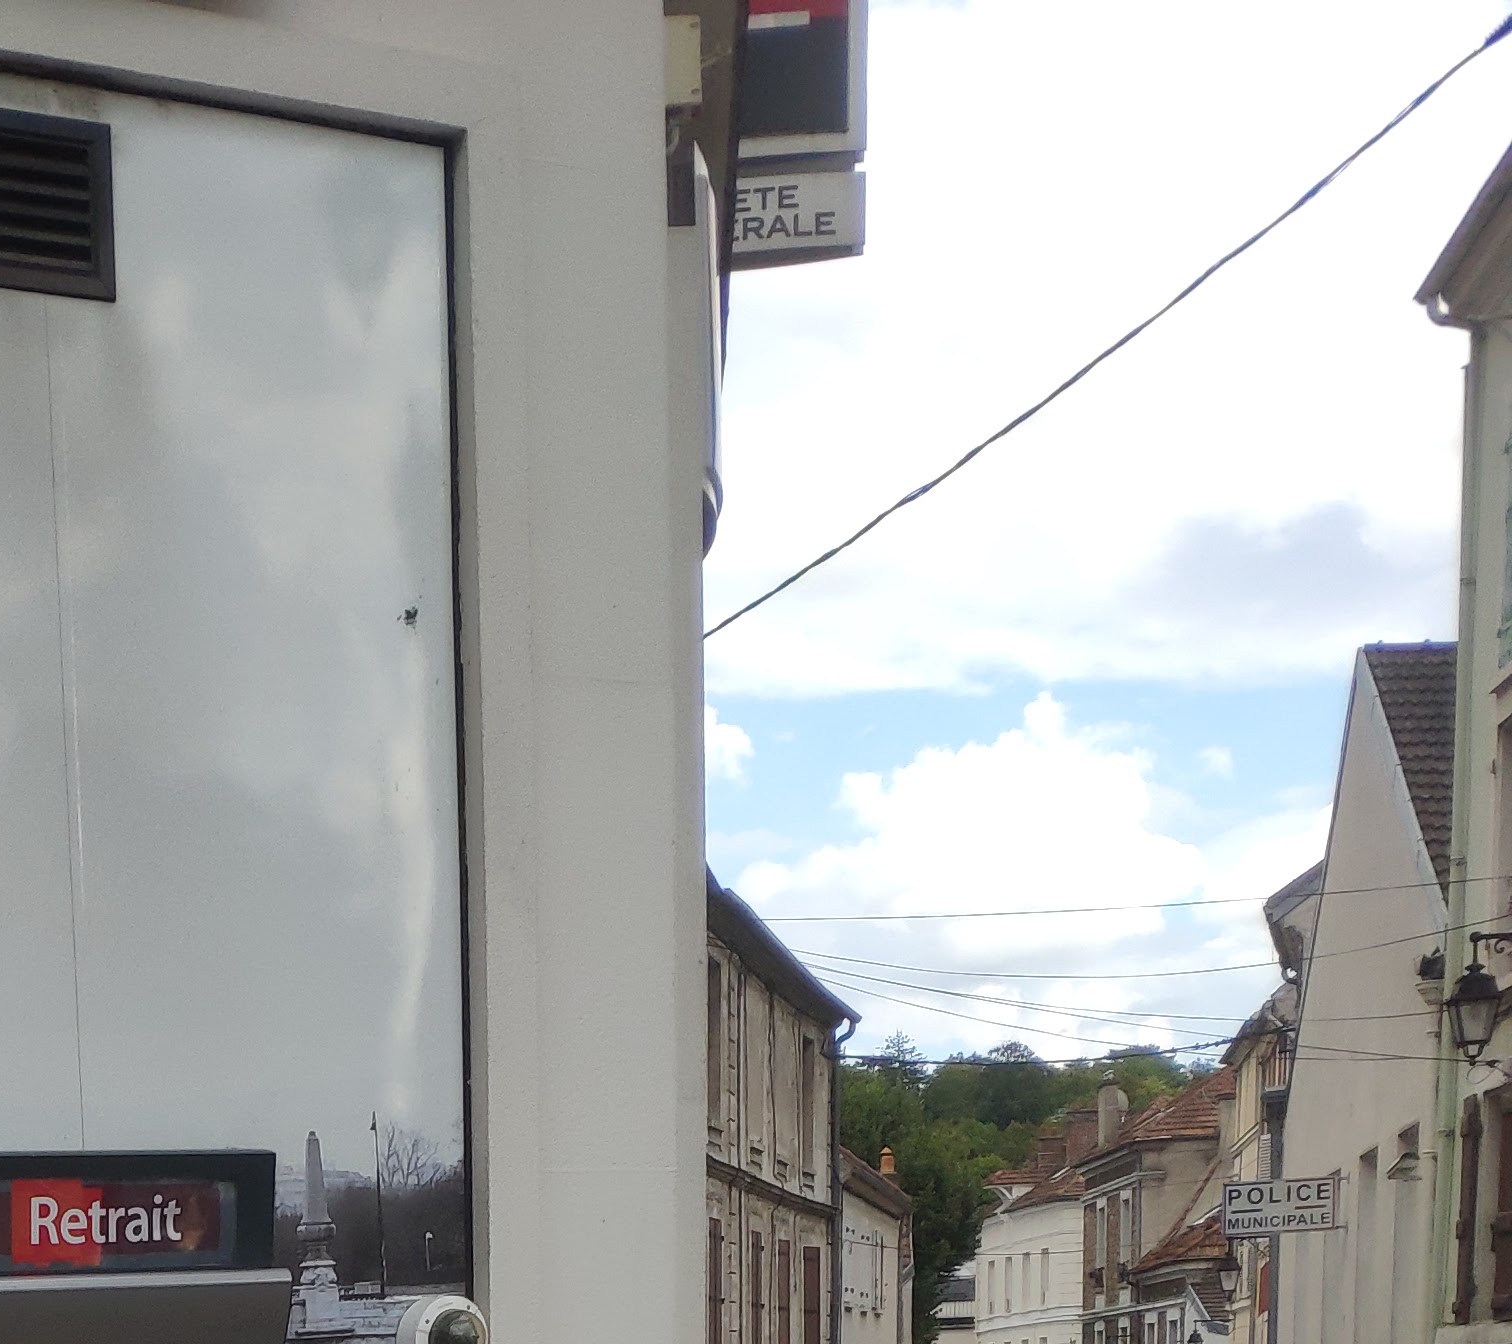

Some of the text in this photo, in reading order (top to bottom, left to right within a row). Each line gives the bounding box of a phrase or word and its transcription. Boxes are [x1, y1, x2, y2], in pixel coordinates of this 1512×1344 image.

[735, 185, 799, 212] ETE
[733, 211, 836, 241] RALE
[1228, 1182, 1331, 1207] POLICE
[29, 1193, 182, 1246] Retrait
[1227, 1212, 1331, 1230] MUNICIPALE
